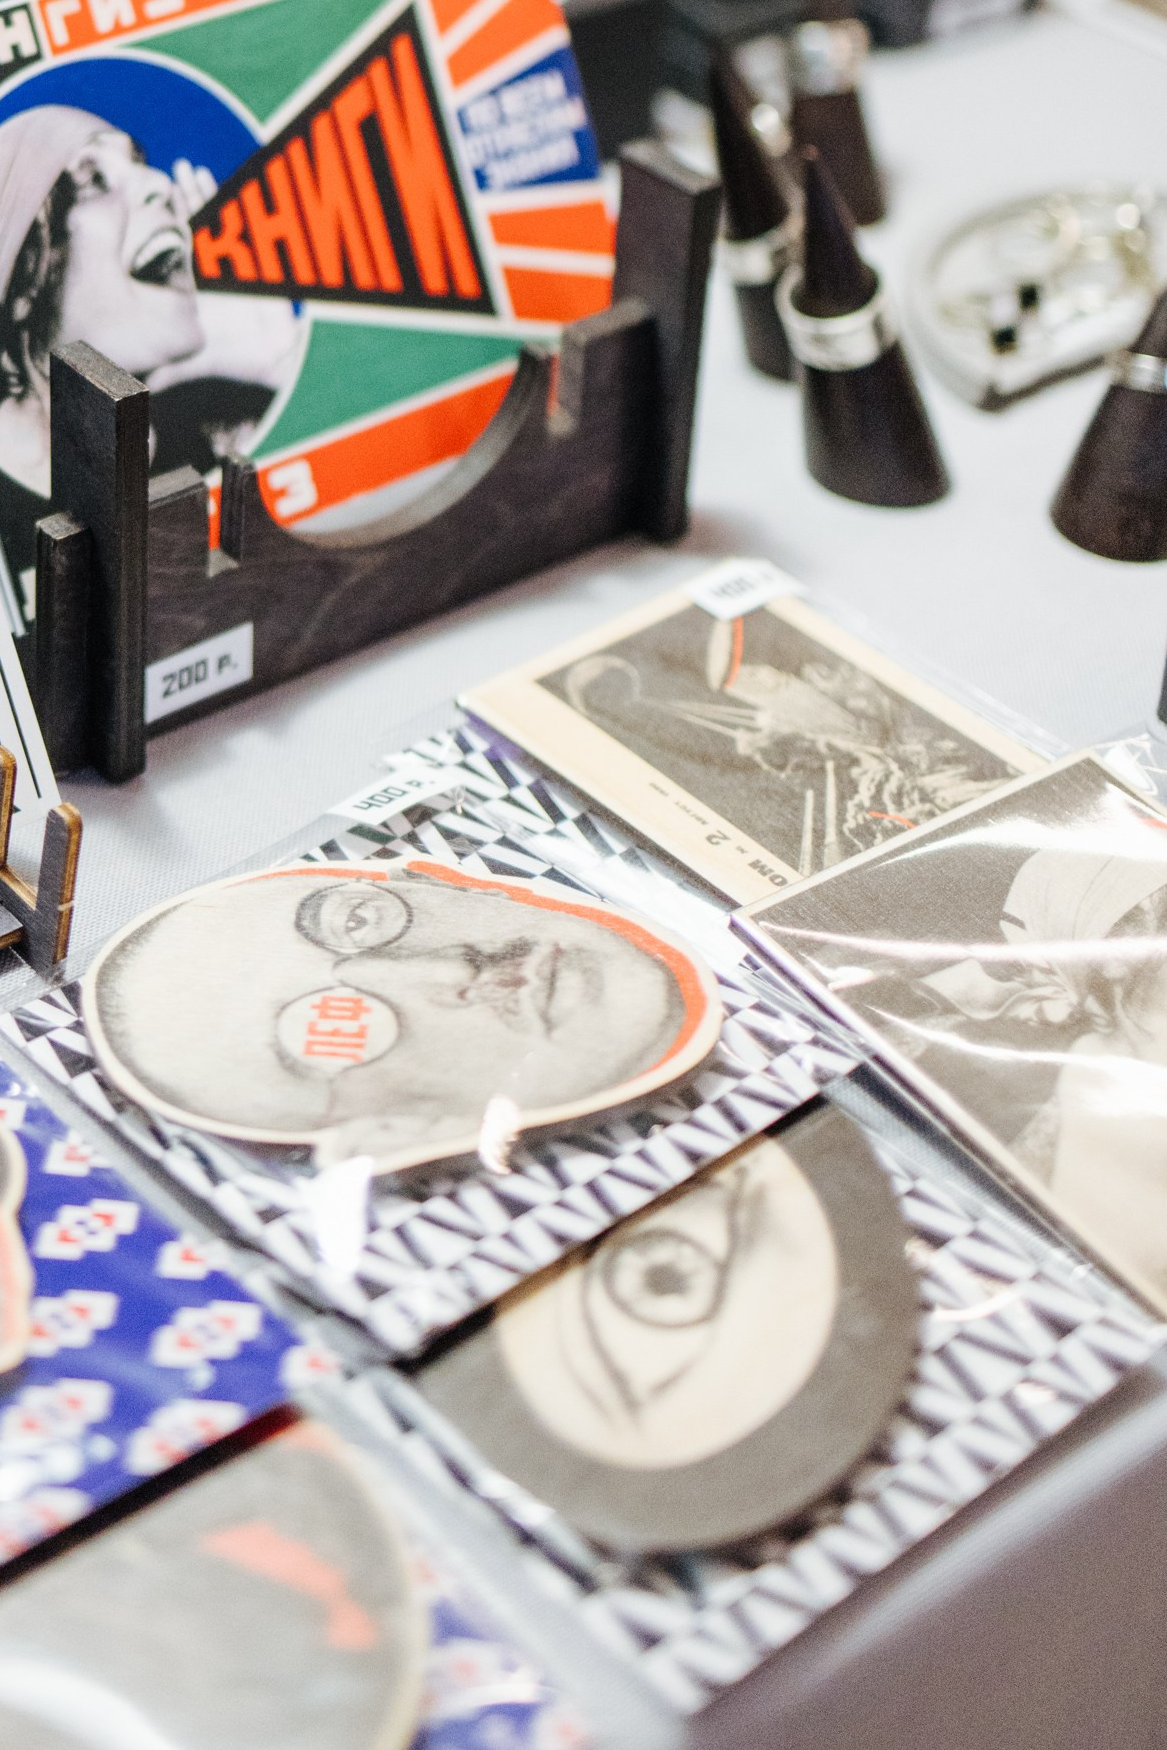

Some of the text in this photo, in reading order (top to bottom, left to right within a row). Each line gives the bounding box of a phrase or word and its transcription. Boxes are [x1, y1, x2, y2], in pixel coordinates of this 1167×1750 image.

[193, 32, 483, 299] КНИГИ
[160, 657, 210, 699] 200
[352, 785, 410, 811] 400
[303, 995, 372, 1064] ЛЕФ
